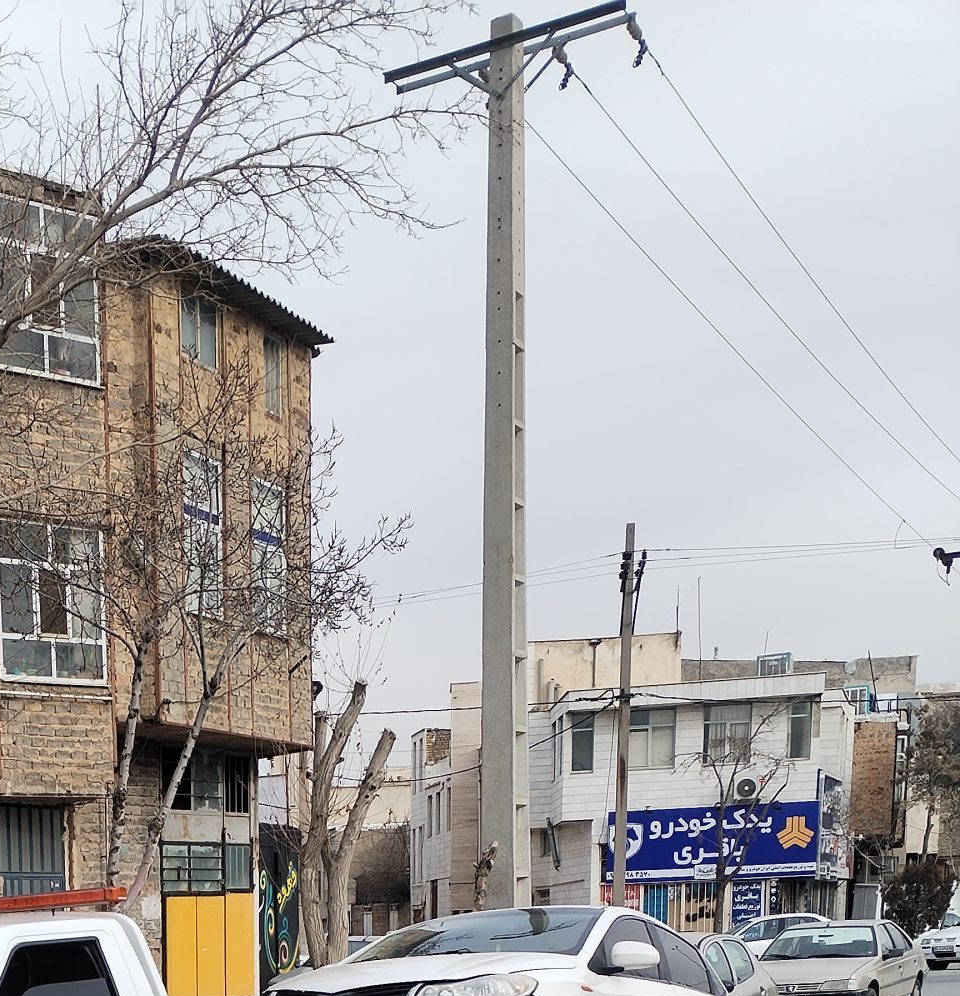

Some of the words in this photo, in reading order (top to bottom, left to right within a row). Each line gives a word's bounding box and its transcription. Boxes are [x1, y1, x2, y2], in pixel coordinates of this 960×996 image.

[649, 811, 716, 840] خودرو
[722, 808, 773, 834] یدک
[673, 838, 744, 865] باقری
[733, 884, 750, 892] خودرو
